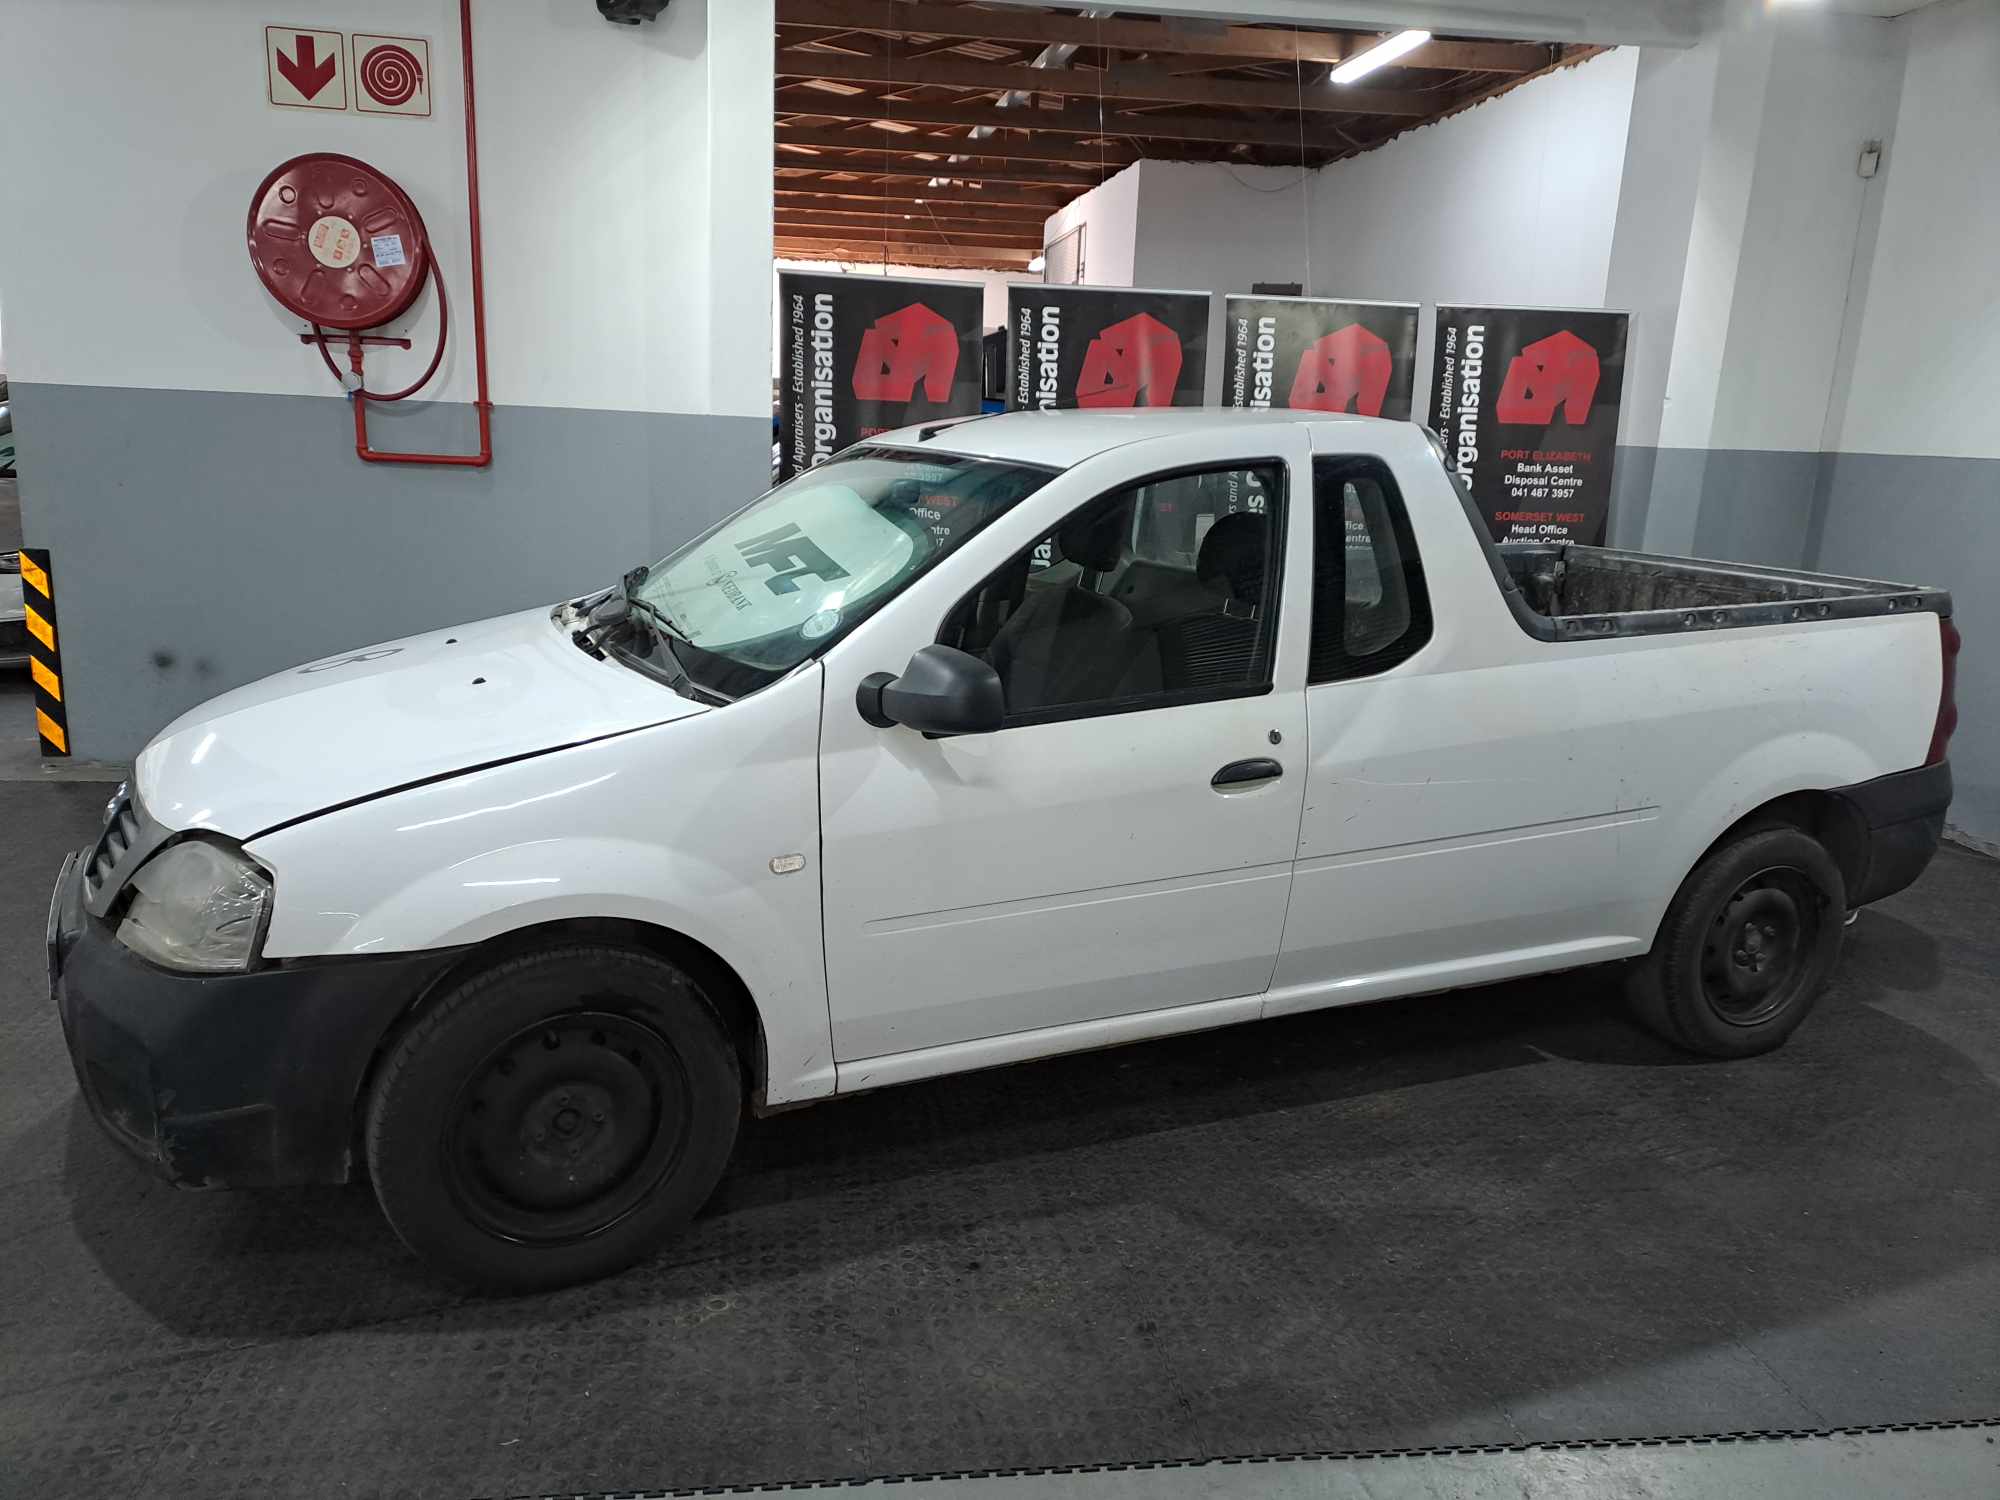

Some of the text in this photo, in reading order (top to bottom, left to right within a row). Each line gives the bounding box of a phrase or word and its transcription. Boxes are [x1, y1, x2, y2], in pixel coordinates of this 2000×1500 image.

[792, 294, 804, 324] 1964
[1020, 307, 1032, 336] 1964
[1237, 318, 1249, 346] 1964
[1446, 327, 1458, 354] 1964
[792, 327, 804, 393] Established
[1018, 338, 1031, 404] Established
[1440, 355, 1455, 420] Established
[792, 403, 806, 463] Appraisers
[1501, 450, 1530, 460] PORT
[1517, 462, 1574, 474] Bank Asset
[1227, 480, 1239, 502] and
[1504, 474, 1583, 486] Disposal Centre
[1511, 487, 1575, 498] 041 487 3957
[1511, 524, 1568, 535] Head Office
[1557, 512, 1584, 523] WEST
